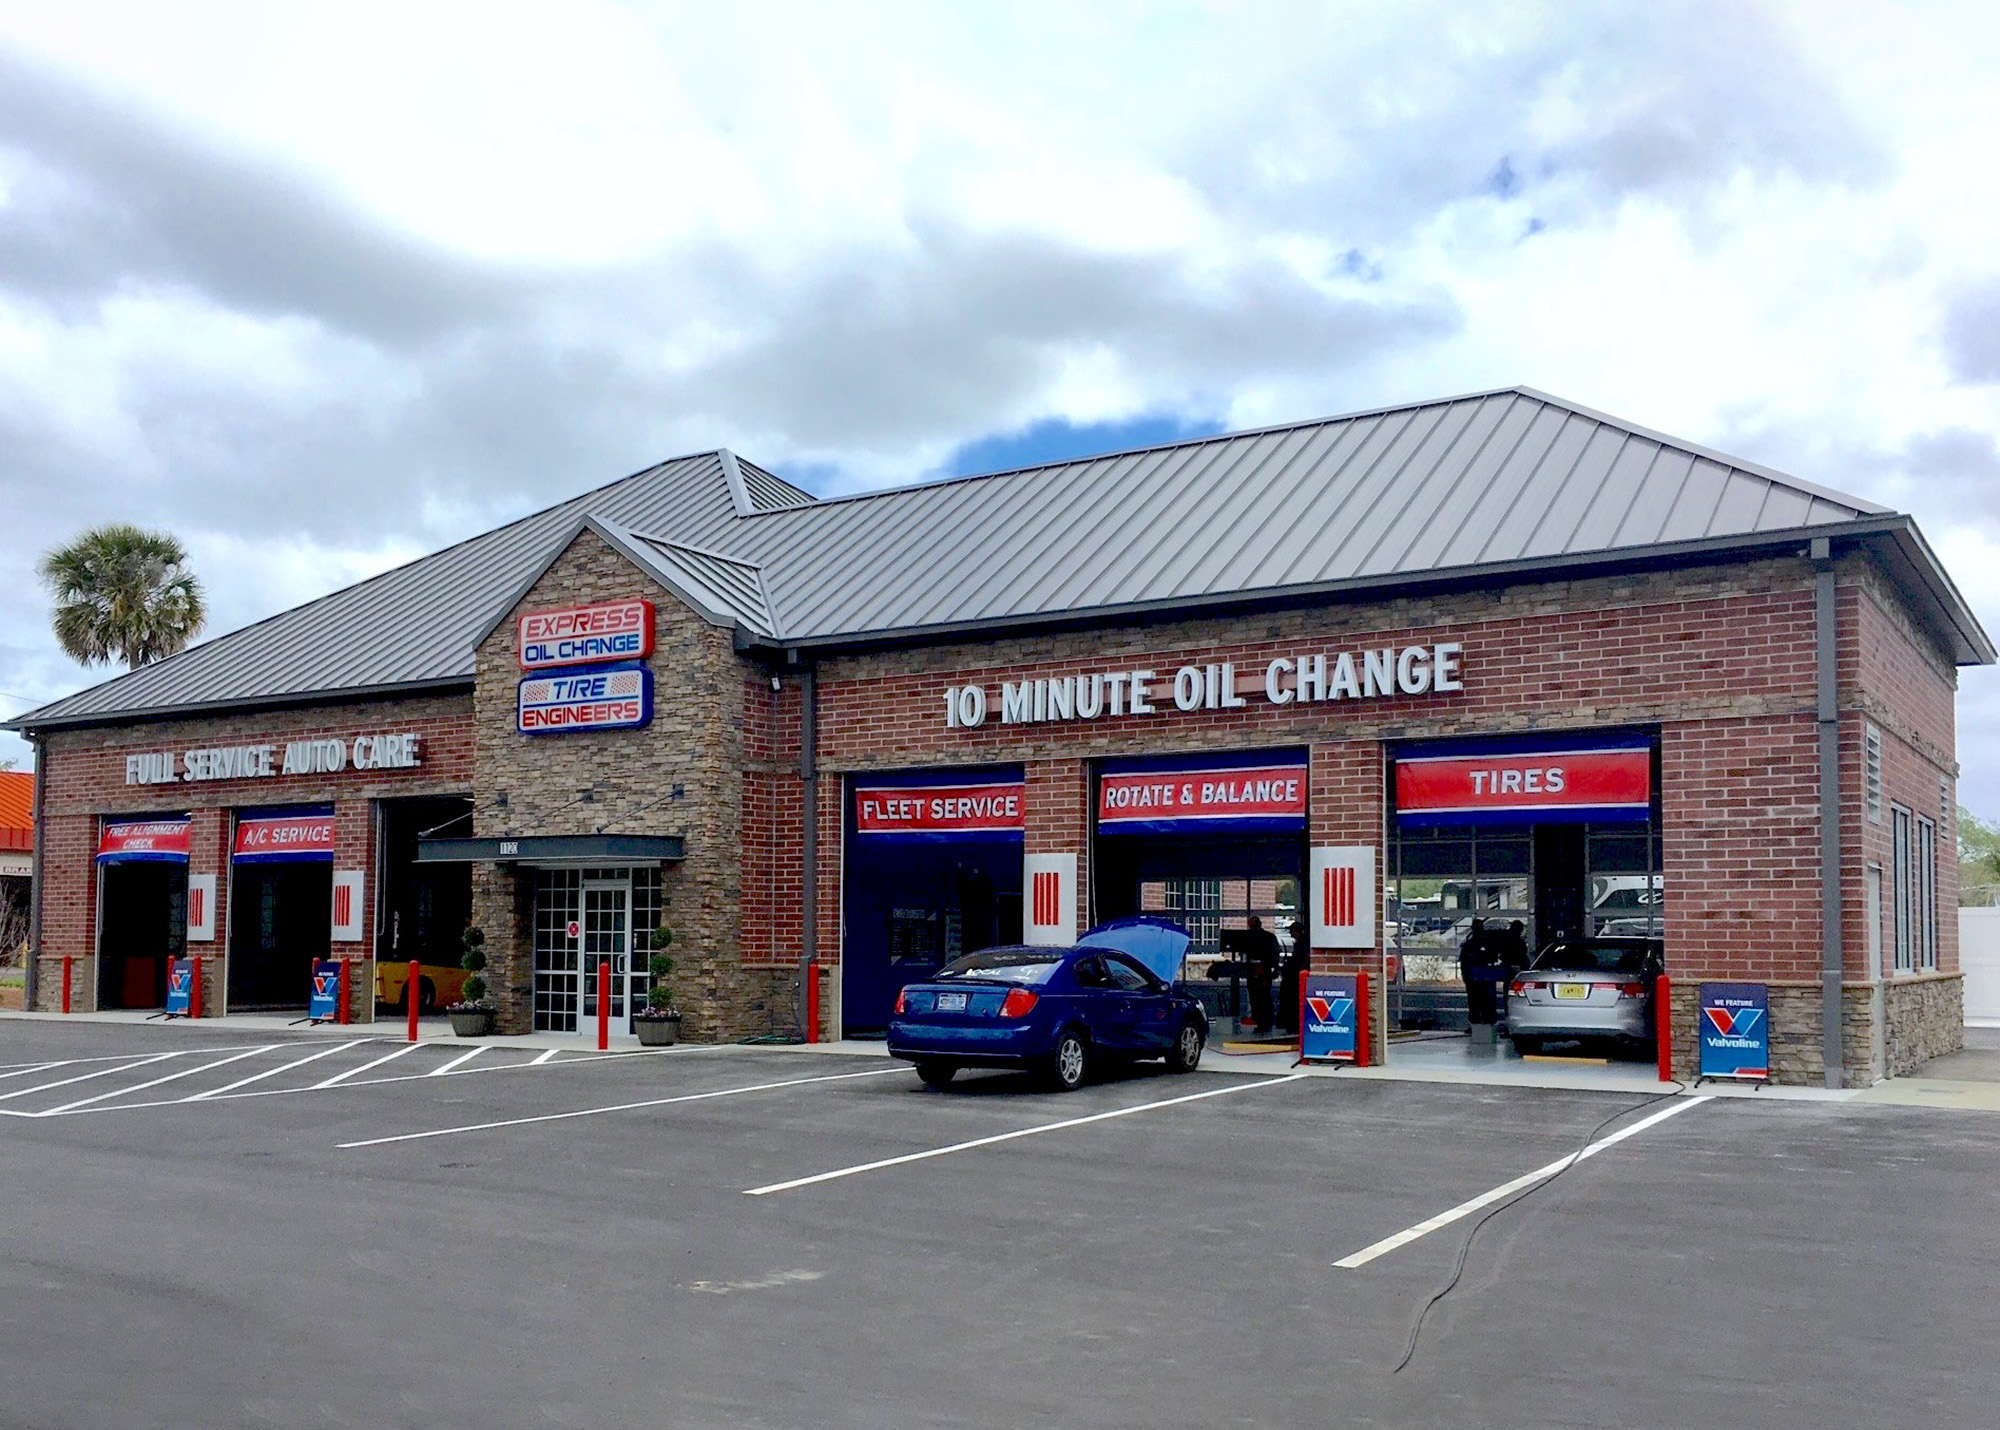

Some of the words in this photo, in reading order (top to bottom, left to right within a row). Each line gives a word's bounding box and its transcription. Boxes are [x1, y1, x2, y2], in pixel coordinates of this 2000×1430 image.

[525, 607, 642, 638] EXPRESS
[525, 644, 555, 662] OIL
[558, 633, 640, 658] CHANGE
[553, 677, 608, 700] TIRE
[943, 686, 987, 728] 10
[1001, 670, 1156, 724] MINUTE
[1173, 663, 1246, 712] OIL
[1265, 642, 1463, 705] CHANGE
[522, 701, 639, 727] ENGINEERS
[125, 753, 179, 785] FULL
[183, 745, 277, 782] SERVICE
[282, 739, 347, 775] AUTO
[353, 733, 422, 770] CARE
[1105, 784, 1173, 808] ROTATE
[1179, 783, 1195, 804] &
[1201, 779, 1299, 803] BALANCE
[1469, 767, 1566, 795] TIRES
[862, 799, 925, 821] FLEET
[930, 796, 1020, 820] SERVICE
[108, 825, 129, 838] FREE
[131, 823, 188, 837] ALIGNMENT
[243, 829, 268, 846] A/C
[271, 825, 331, 843] SERVICE
[122, 838, 154, 850] CHECK
[1308, 1023, 1350, 1033] Valvoline
[1707, 1037, 1761, 1049] Valvoline
